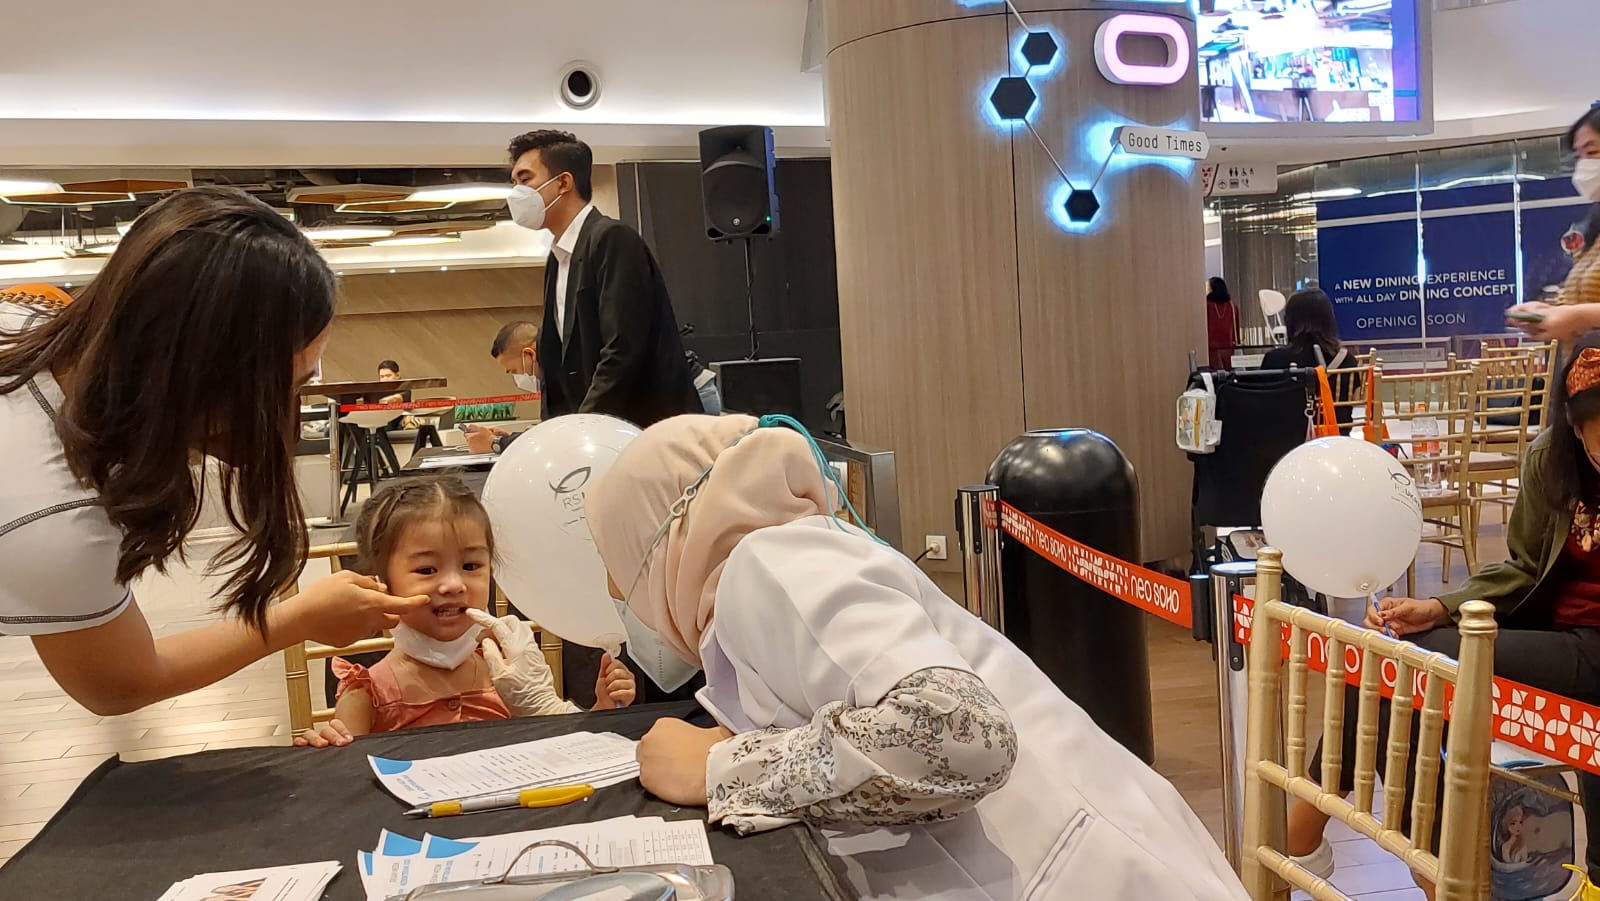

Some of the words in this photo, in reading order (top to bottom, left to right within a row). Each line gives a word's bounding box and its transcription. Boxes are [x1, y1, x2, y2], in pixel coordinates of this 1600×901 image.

[1128, 132, 1158, 149] Good
[1165, 135, 1202, 152] Times
[1334, 282, 1341, 290] A
[1343, 278, 1372, 290] NEW
[1375, 275, 1420, 288] DINING
[1426, 269, 1506, 285] EXPERIENCE
[1334, 296, 1354, 304] WITH
[1356, 295, 1374, 304] ALL
[1376, 292, 1397, 302] DAY
[1453, 283, 1516, 298] CONCEPT
[1356, 314, 1417, 329] OPENING
[1426, 312, 1466, 326] SOON
[1130, 574, 1152, 602] neo
